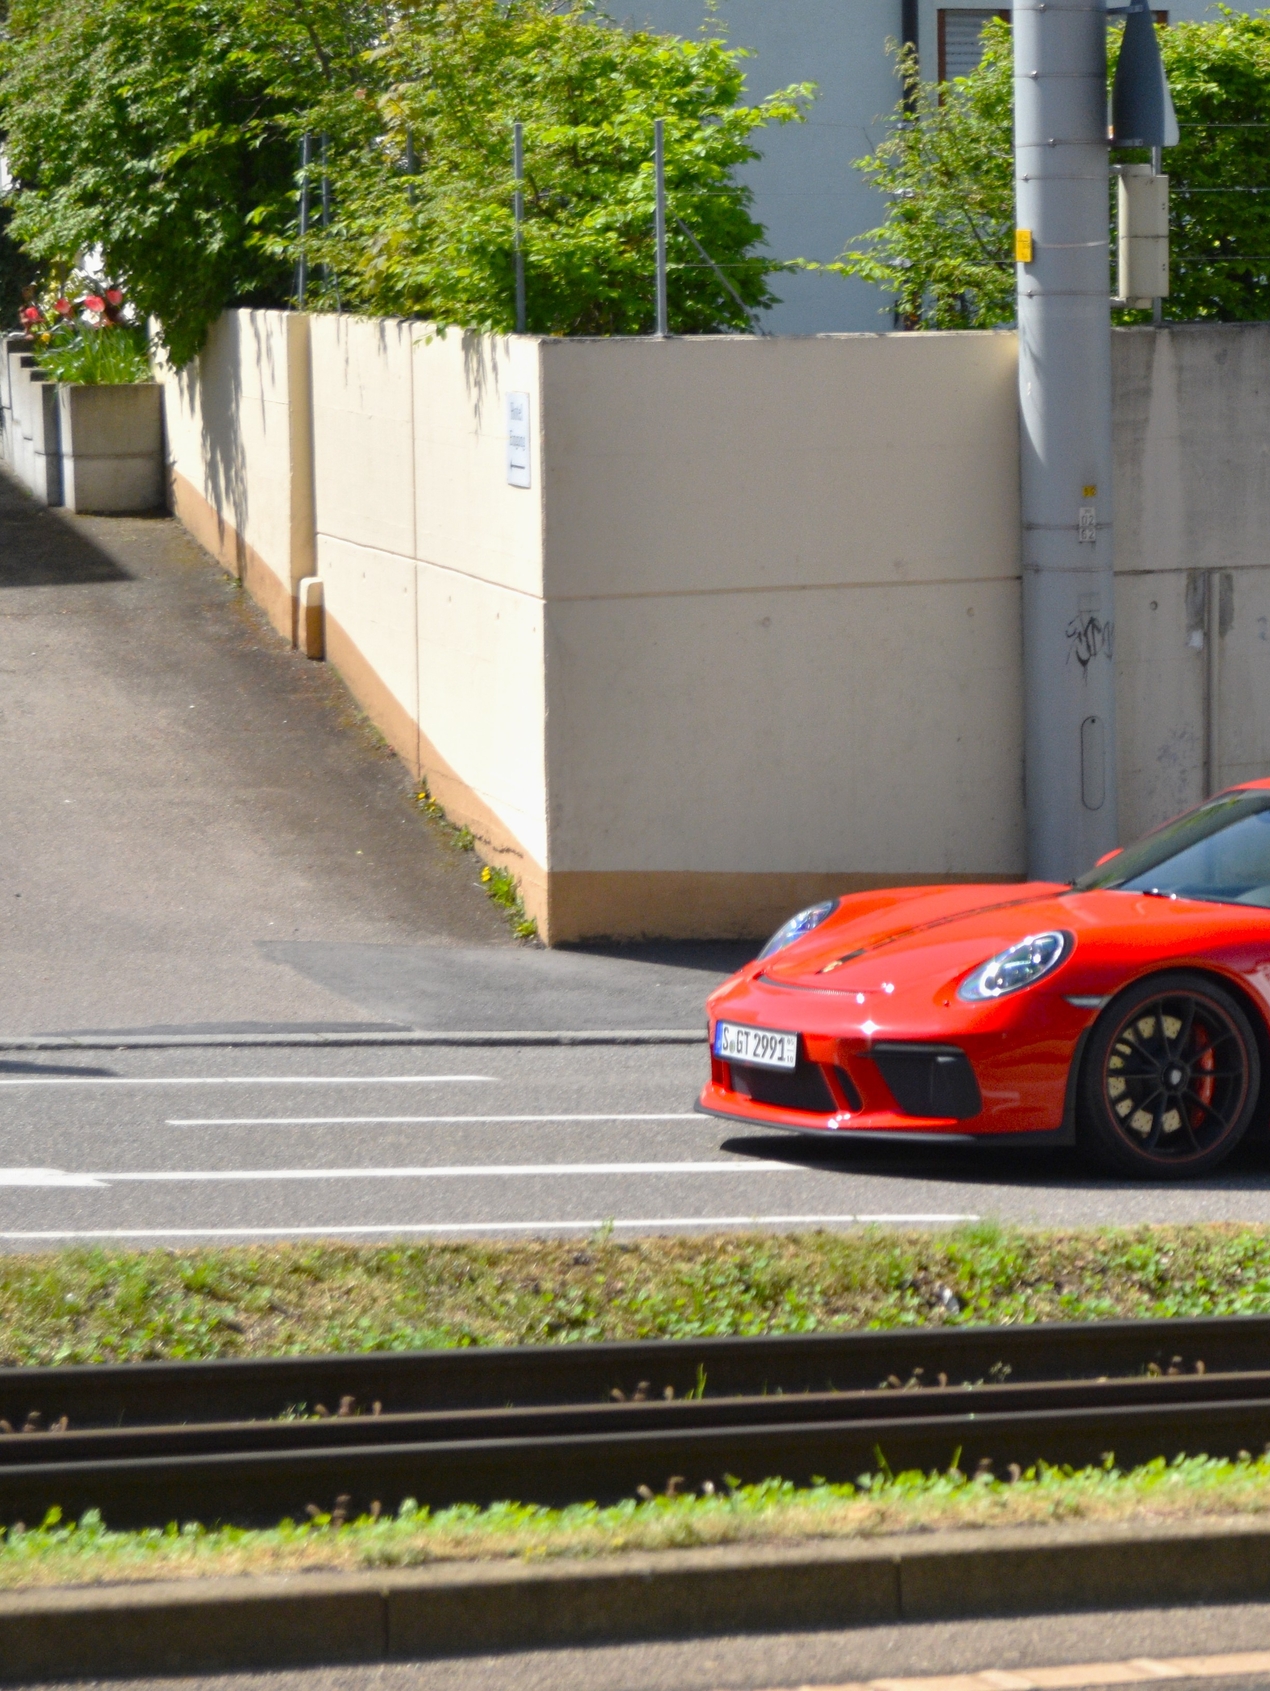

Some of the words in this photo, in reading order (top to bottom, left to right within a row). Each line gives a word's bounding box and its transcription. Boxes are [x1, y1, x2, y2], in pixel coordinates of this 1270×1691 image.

[722, 1026, 730, 1051] S
[736, 1030, 751, 1055] GT
[753, 1032, 786, 1062] 2991
